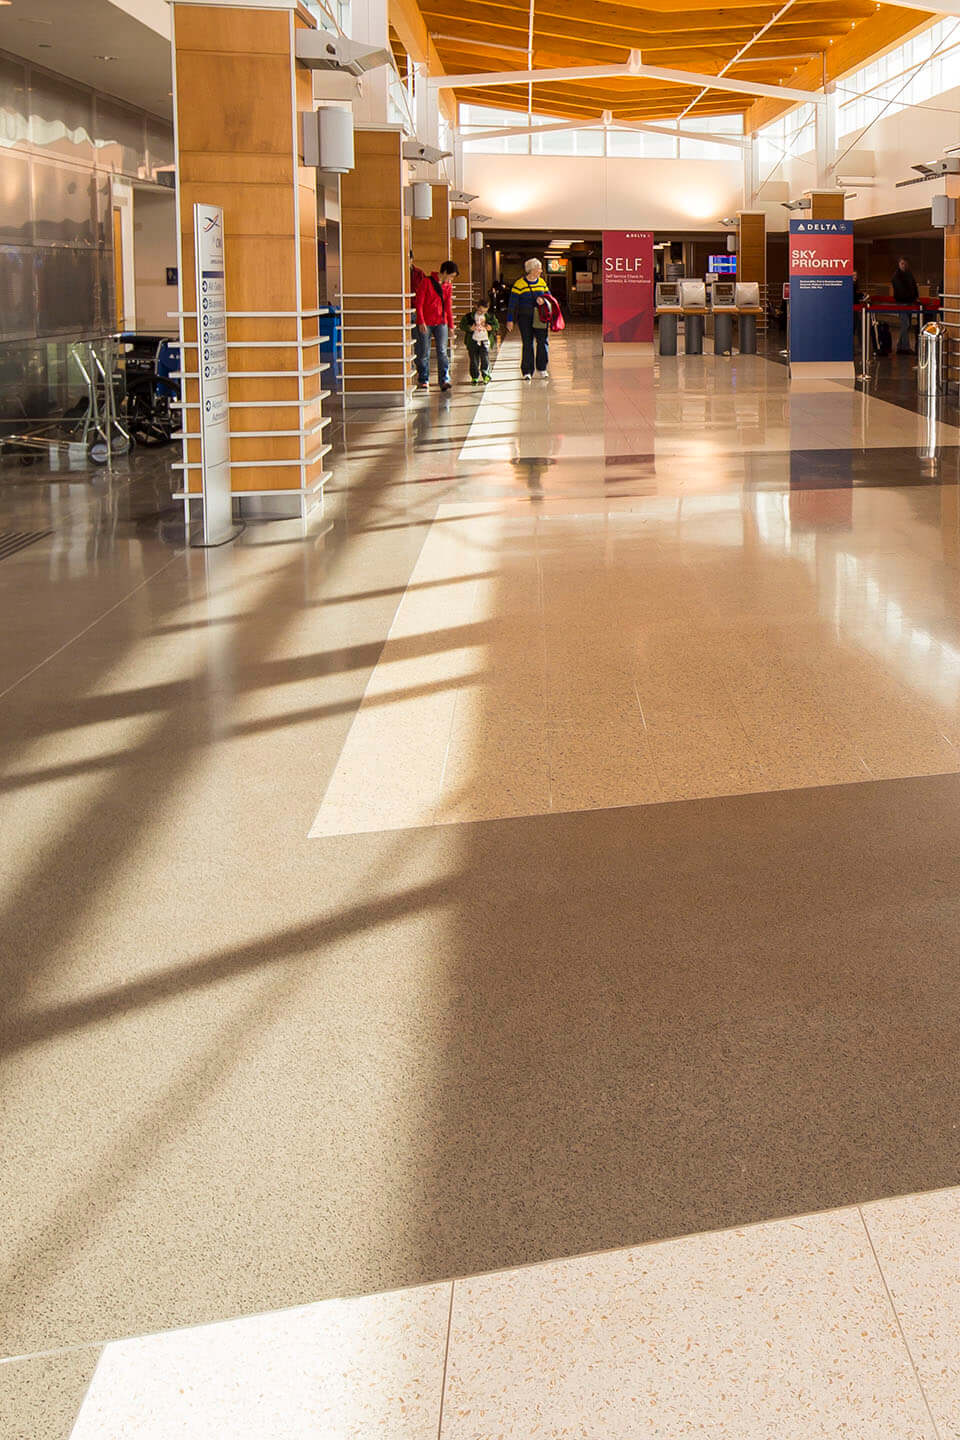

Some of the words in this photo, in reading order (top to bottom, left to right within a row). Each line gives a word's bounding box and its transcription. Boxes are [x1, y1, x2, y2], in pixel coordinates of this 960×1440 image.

[792, 250, 816, 259] SKY
[605, 257, 643, 271] SELF
[792, 259, 848, 268] PRIORITY
